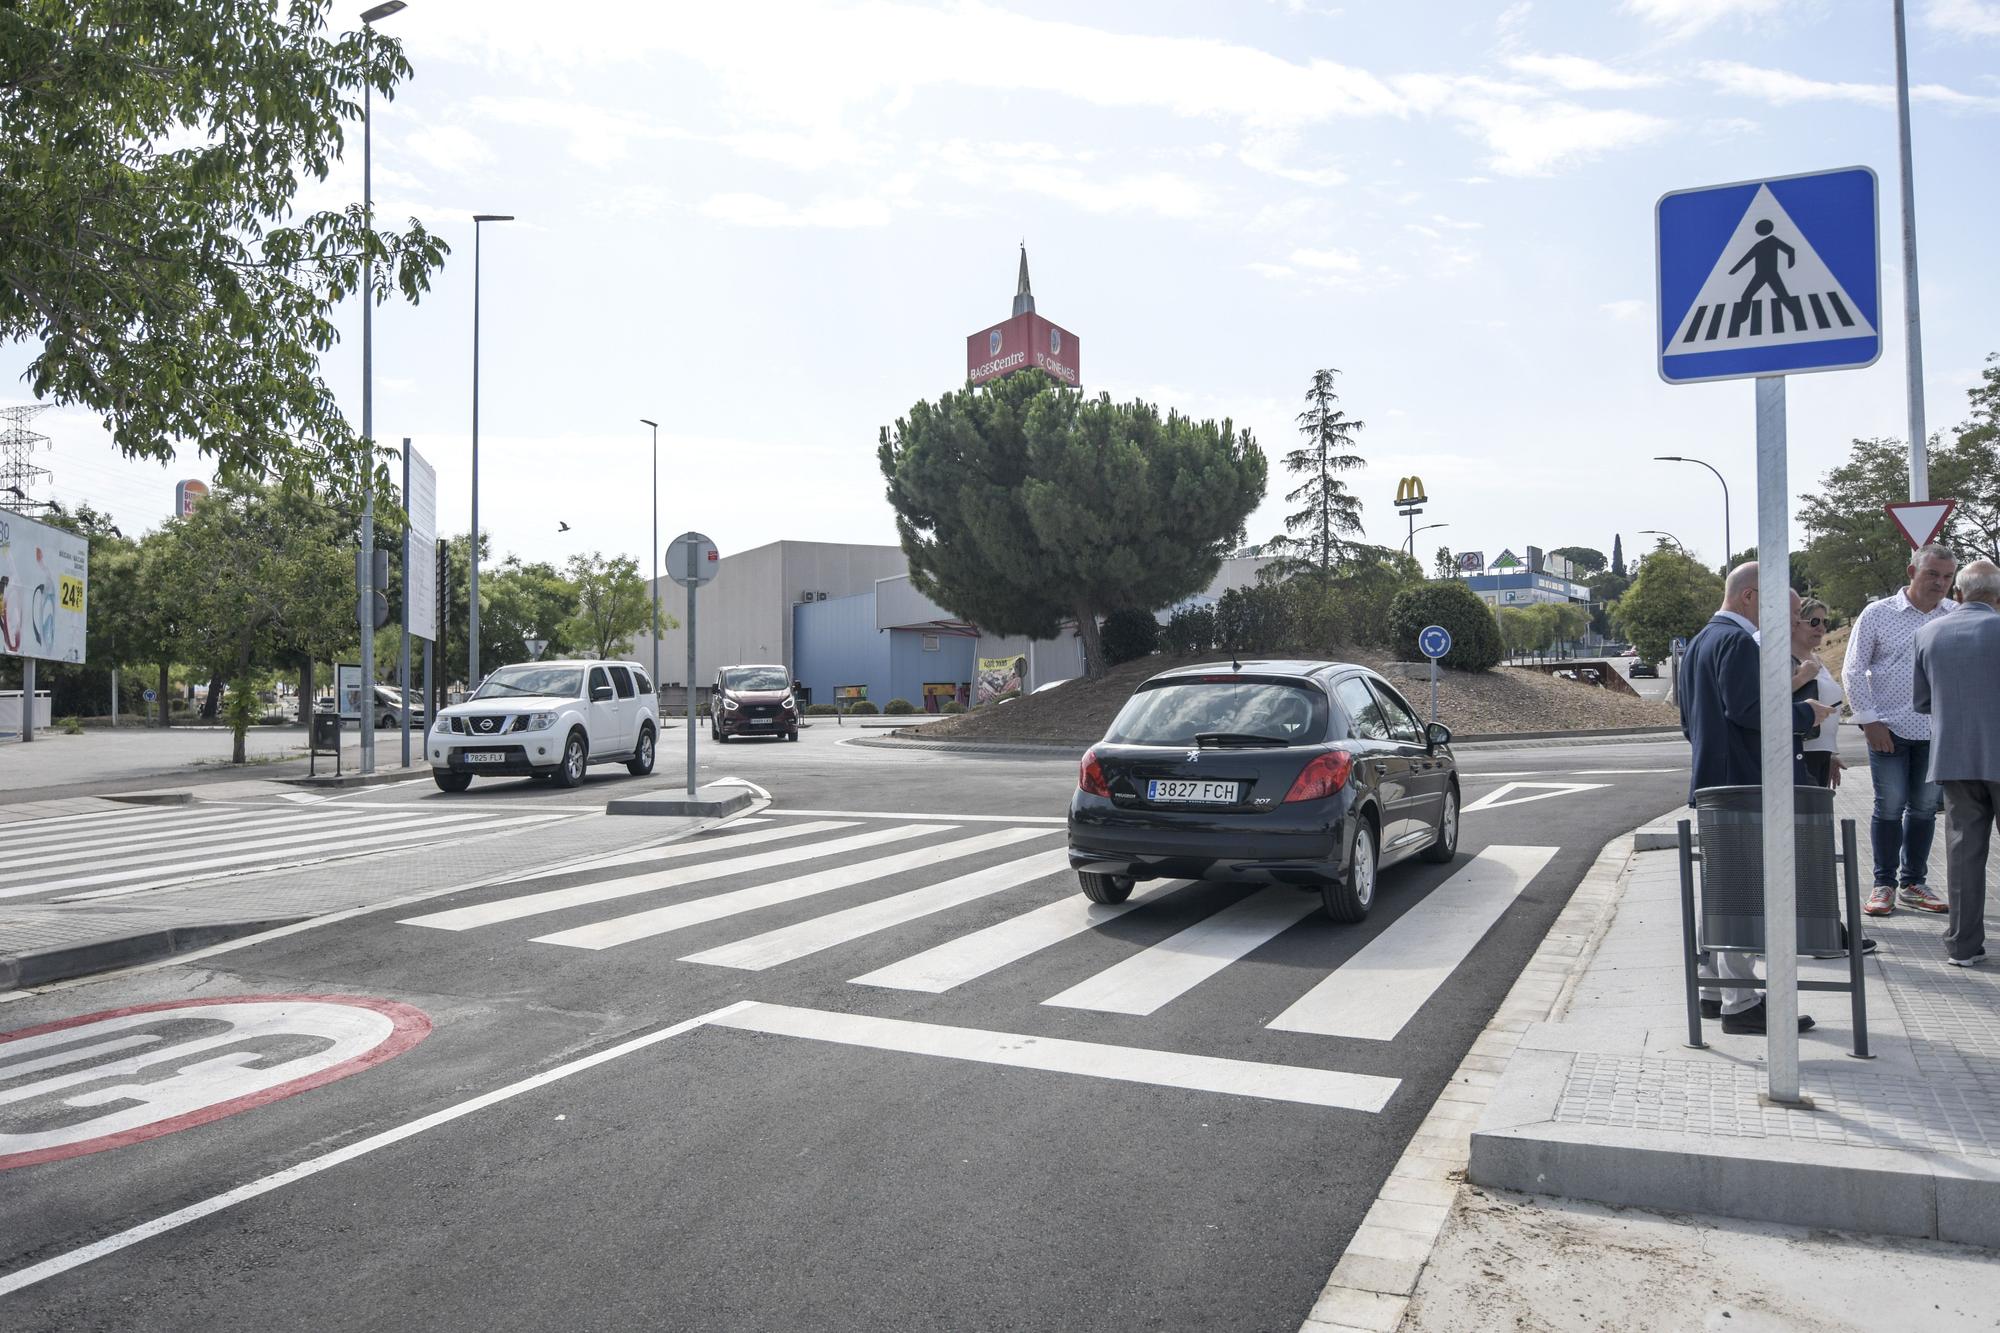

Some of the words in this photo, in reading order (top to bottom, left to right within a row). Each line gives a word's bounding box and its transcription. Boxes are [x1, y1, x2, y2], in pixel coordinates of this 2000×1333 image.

[1036, 352, 1045, 367] 12
[470, 754, 487, 762] 7825
[489, 754, 503, 762] FLX
[1158, 782, 1198, 798] 3827
[1203, 784, 1236, 800] FCH
